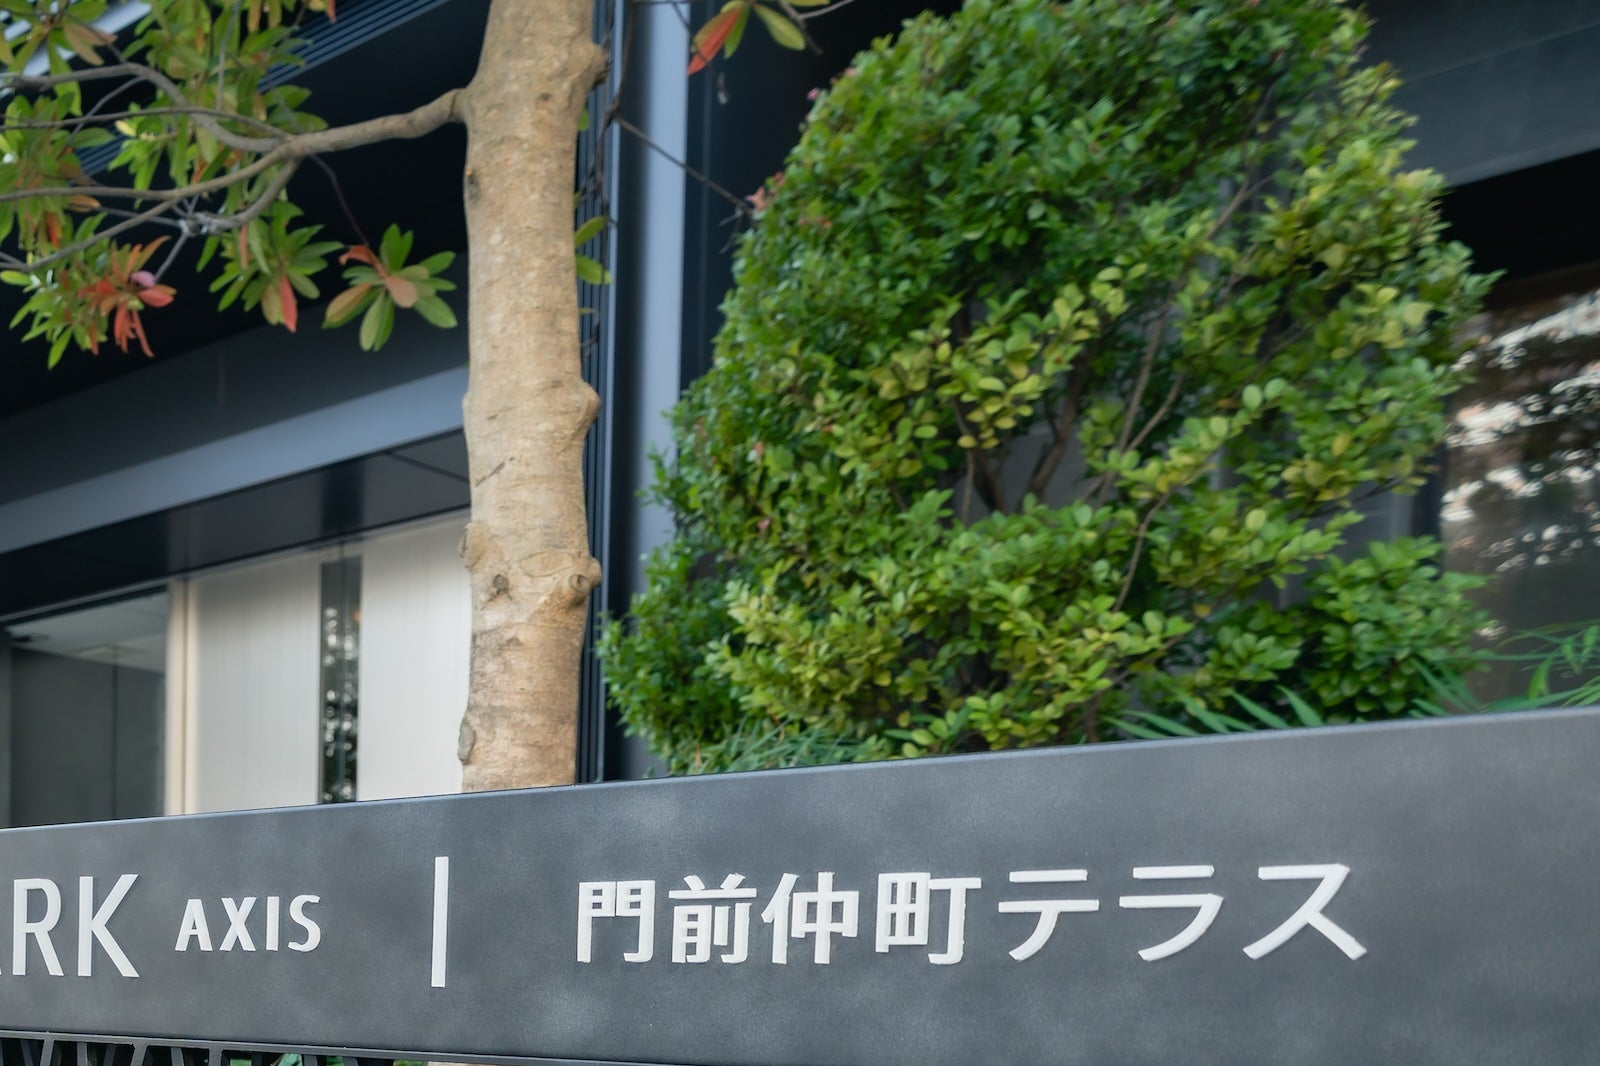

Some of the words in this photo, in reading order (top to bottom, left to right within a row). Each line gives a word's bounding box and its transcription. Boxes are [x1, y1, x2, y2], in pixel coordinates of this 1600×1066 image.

[173, 893, 323, 954] AXIS
[575, 860, 1369, 967] 門前仲町テラス
